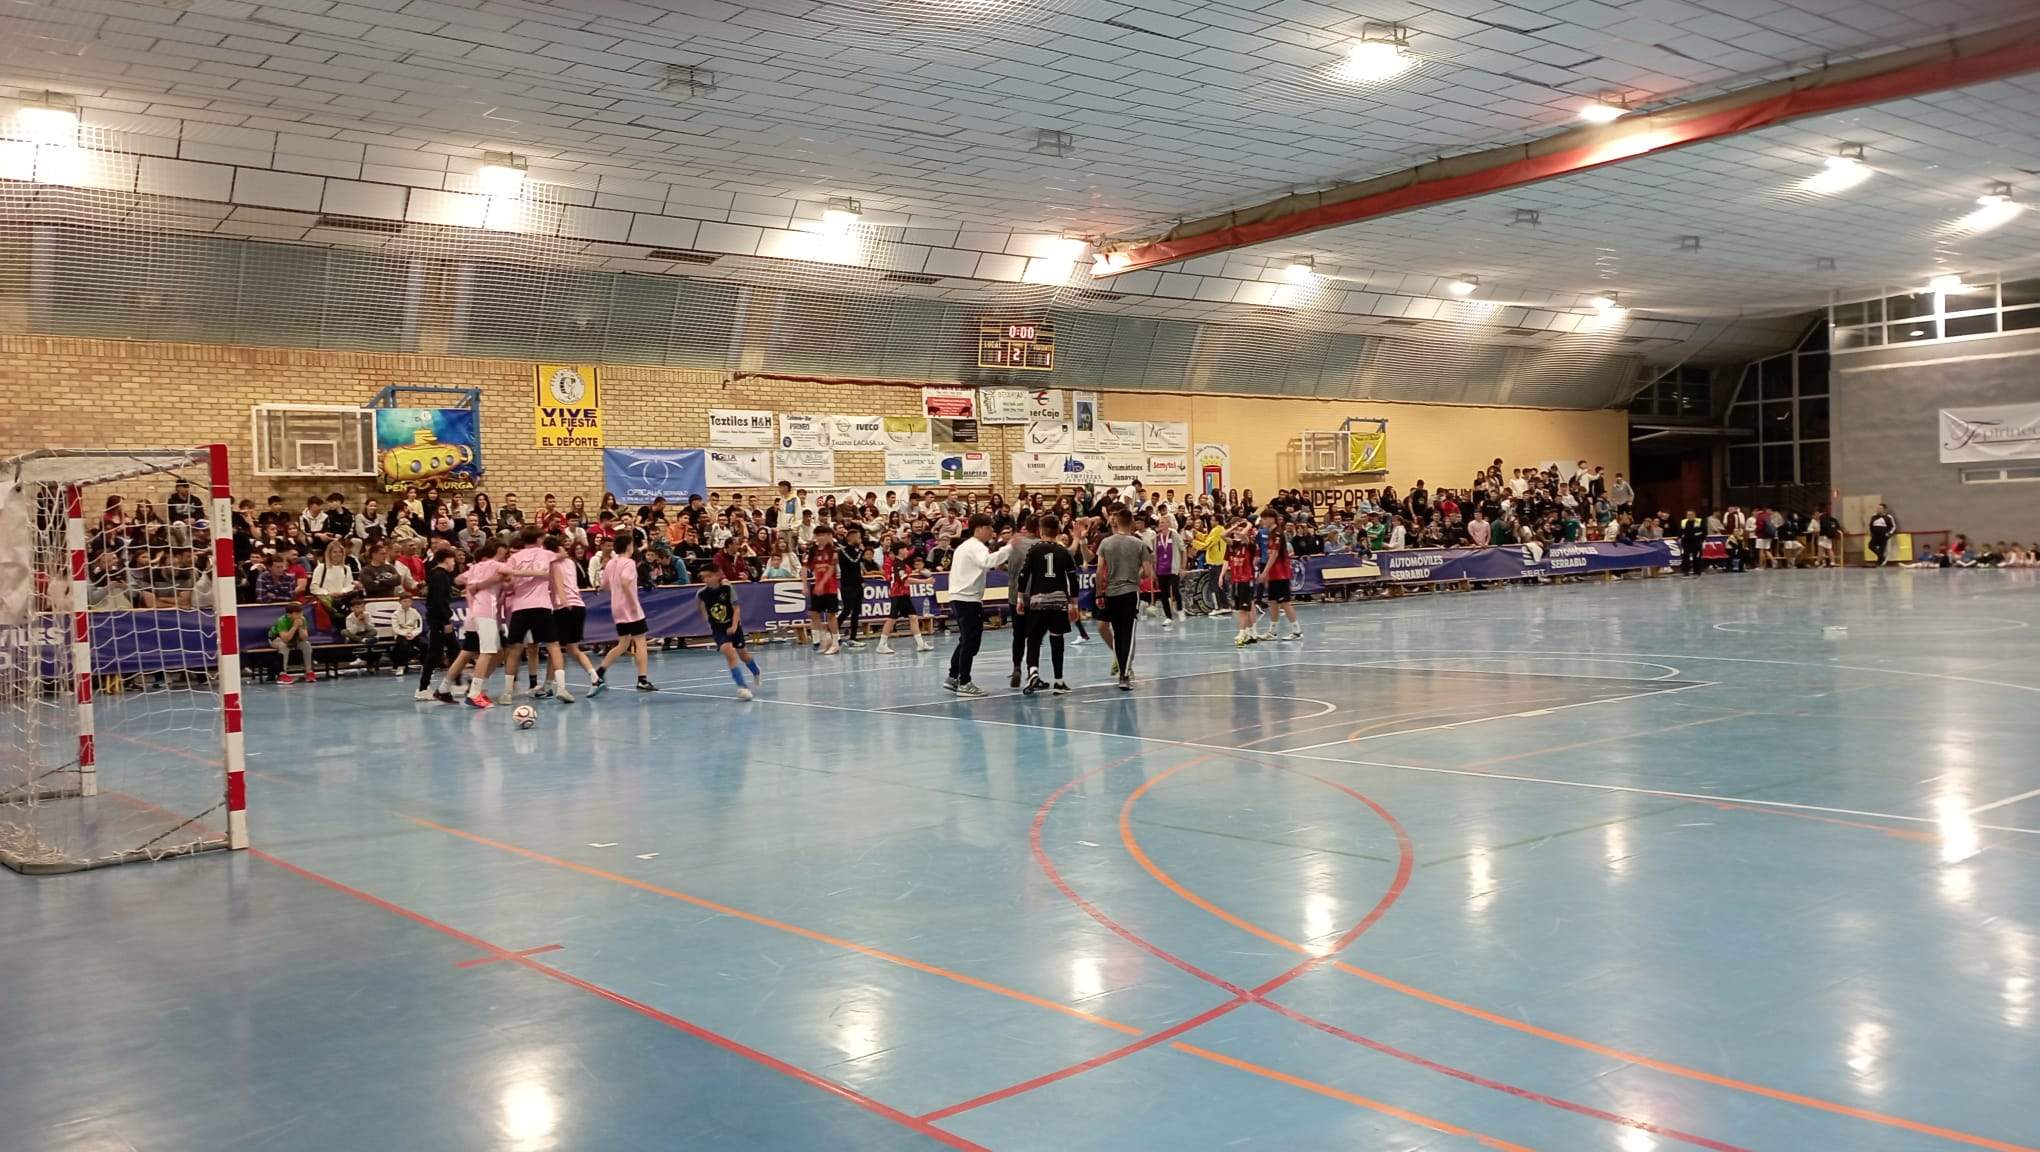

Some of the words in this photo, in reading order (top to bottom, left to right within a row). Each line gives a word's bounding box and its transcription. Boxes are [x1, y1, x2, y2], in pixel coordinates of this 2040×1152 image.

[1009, 326, 1034, 339] 0:00
[998, 351, 1001, 362] 1
[1013, 348, 1020, 360] 2
[541, 408, 597, 418] VIVE
[541, 418, 557, 427] LA
[560, 418, 597, 427] FIESTA
[710, 415, 749, 427] Textiles
[751, 416, 772, 427] H&H
[567, 428, 574, 436] Y
[856, 423, 879, 431] IVECO
[542, 437, 553, 446] EL
[557, 437, 599, 446] DEPORTE
[1107, 463, 1143, 471] Neumáticos
[1044, 553, 1056, 577] 1
[1389, 555, 1443, 568] AUTOMÓVILES
[1551, 558, 1587, 569] SERRABLO
[1390, 569, 1431, 580] SERRABLO
[1520, 568, 1546, 577] SEAT
